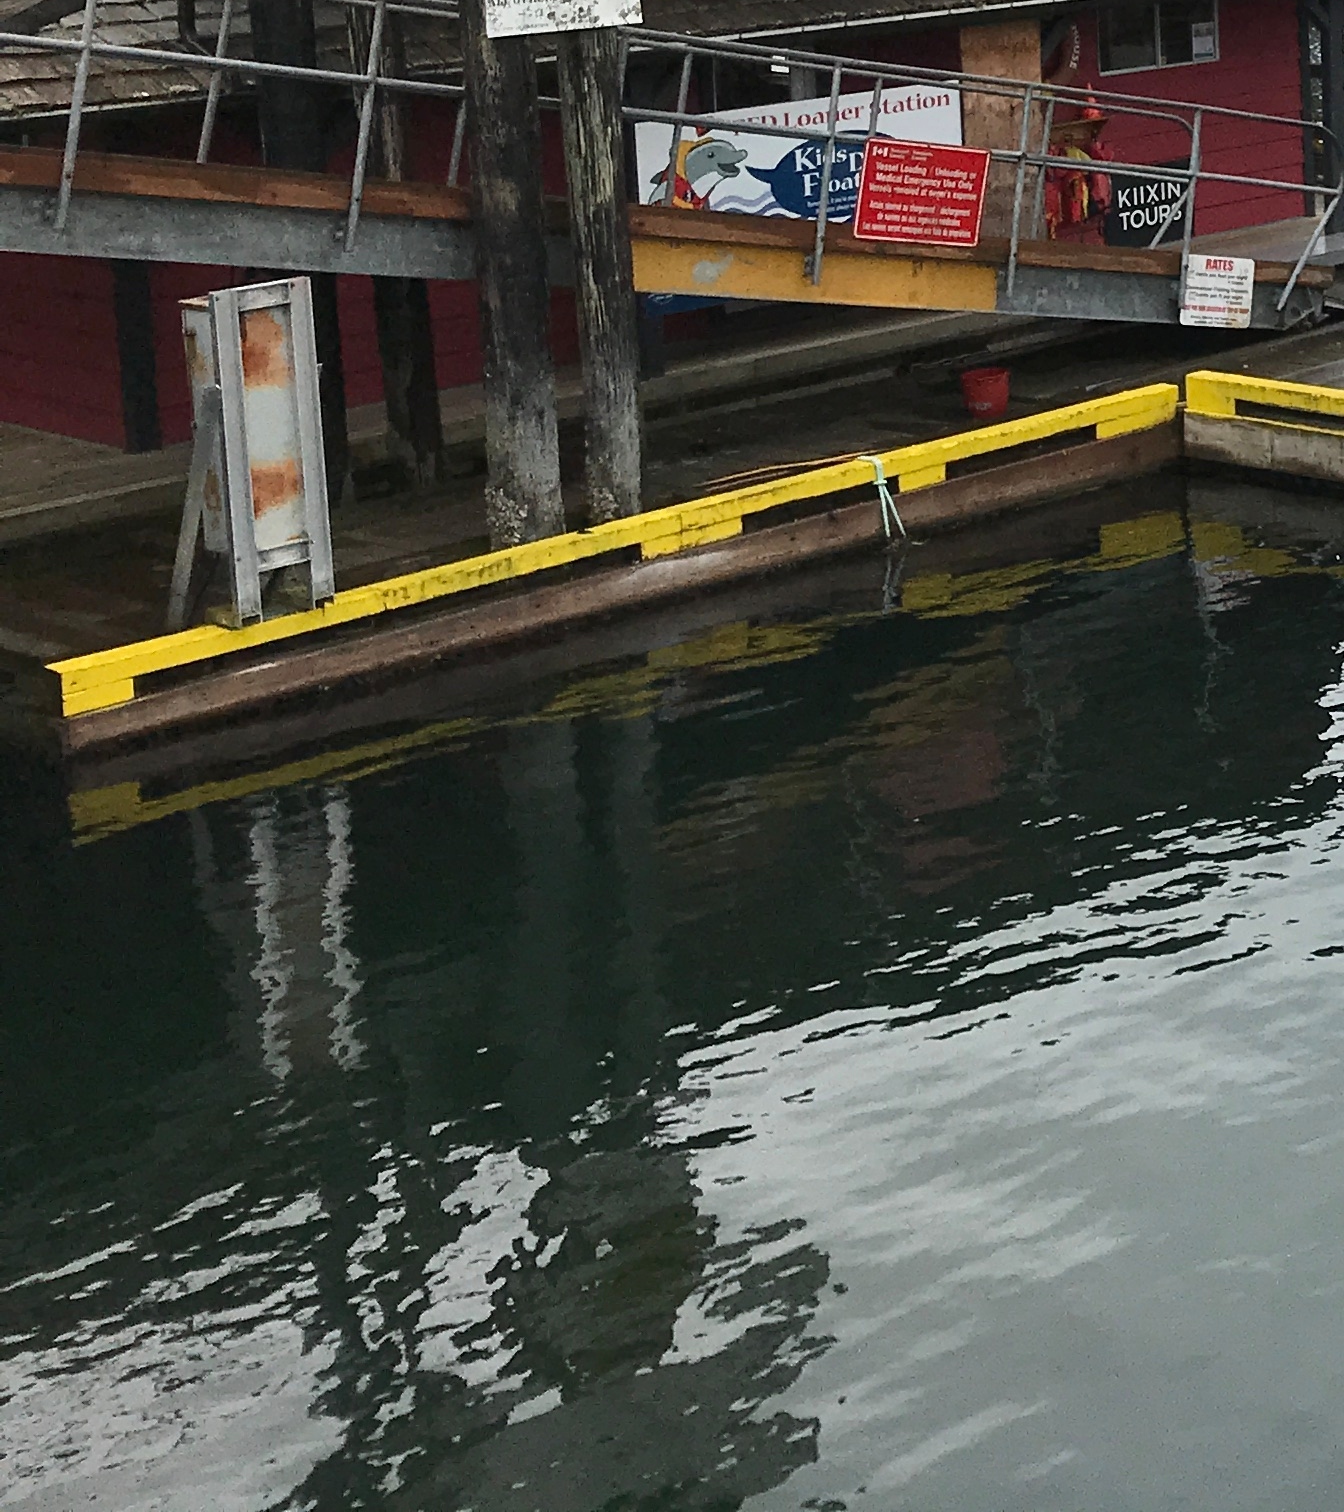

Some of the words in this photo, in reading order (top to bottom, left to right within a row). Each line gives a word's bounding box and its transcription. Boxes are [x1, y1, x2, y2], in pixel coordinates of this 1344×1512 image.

[802, 172, 860, 197] Foat
[1119, 203, 1182, 230] TOURS
[1206, 258, 1234, 272] RATES
